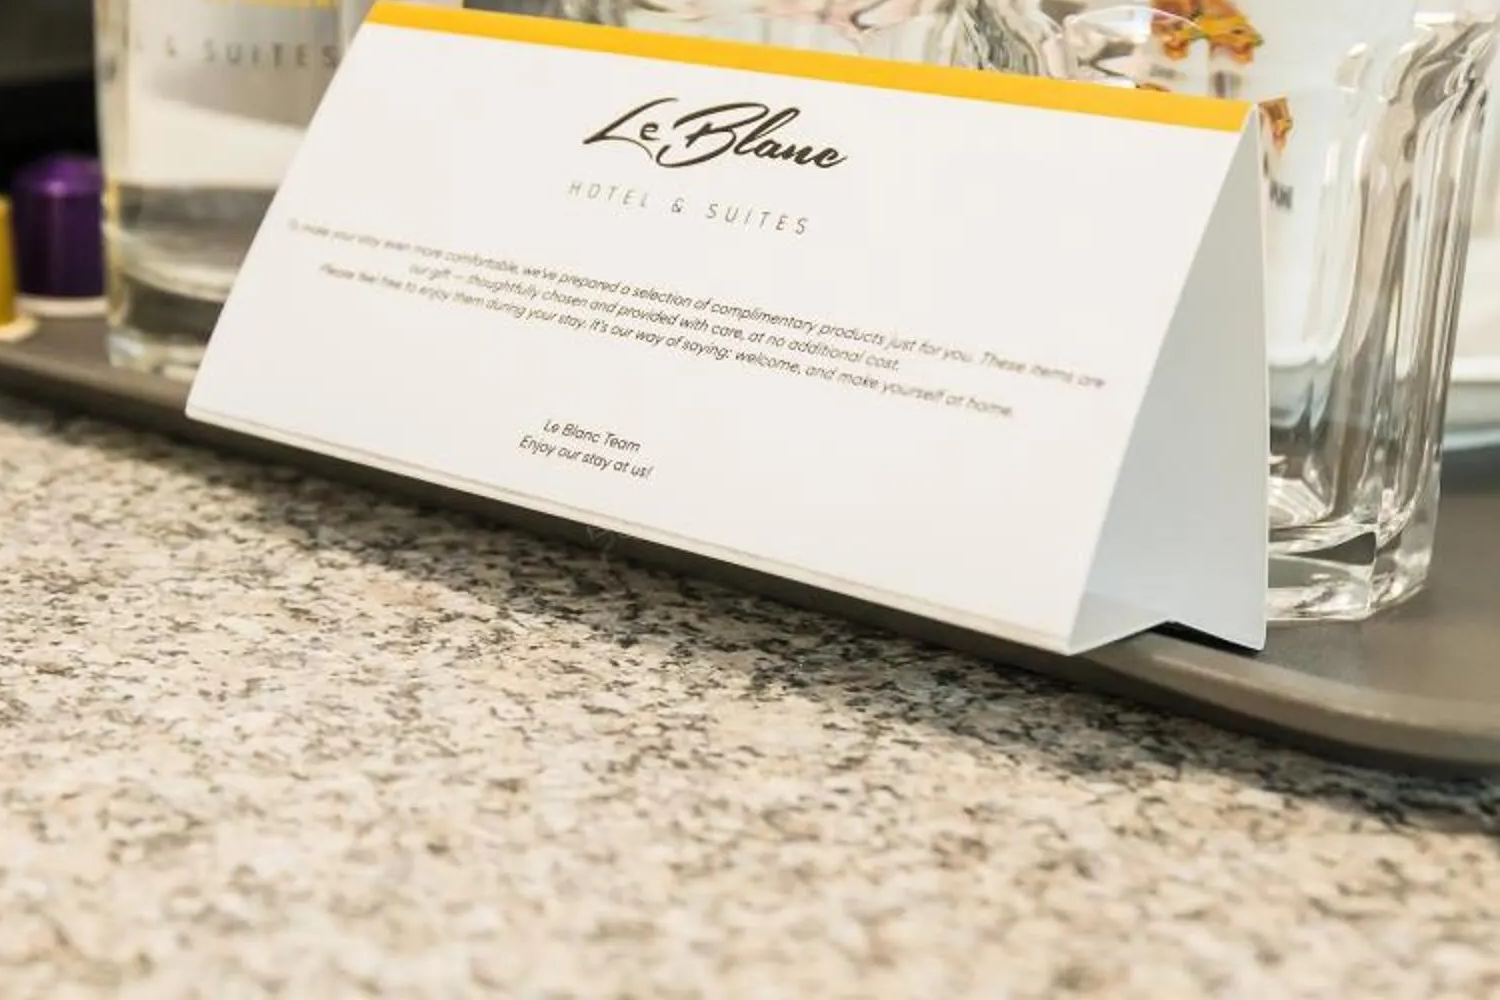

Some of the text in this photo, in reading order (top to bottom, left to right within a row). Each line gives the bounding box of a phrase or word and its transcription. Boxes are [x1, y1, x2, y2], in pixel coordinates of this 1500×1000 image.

[582, 97, 848, 168] Le Blanc
[568, 180, 809, 235] HOTEL & SUITES
[404, 280, 418, 293] to
[418, 285, 450, 302] enjoy
[451, 290, 485, 306] them
[485, 297, 527, 318] during
[525, 304, 558, 322] your
[610, 324, 634, 338] our
[634, 328, 666, 347] way
[665, 334, 686, 348] of
[681, 338, 732, 361] saying:
[734, 350, 802, 376] welcome,
[804, 363, 837, 381] and
[837, 371, 880, 390] make
[883, 381, 944, 401] yourself
[944, 393, 965, 407] at
[414, 244, 443, 259] more
[522, 266, 558, 281] we've
[558, 272, 623, 293] prepared
[621, 284, 631, 296] a
[632, 285, 693, 308] selection
[693, 297, 712, 311] of
[711, 301, 817, 334] complimentary
[818, 323, 886, 347] products
[884, 335, 917, 352] just
[918, 339, 943, 355] for
[980, 350, 1027, 374] These
[1029, 363, 1074, 384] items
[1077, 373, 1107, 389] are
[466, 273, 539, 300] thoughtfully
[541, 288, 589, 308] chosen
[589, 297, 620, 313] and
[616, 304, 681, 326] provided
[679, 314, 709, 332] with
[711, 321, 745, 341] care,
[746, 331, 765, 344] at
[765, 335, 786, 348] no
[787, 338, 865, 363] additional
[865, 354, 901, 373] cost.
[519, 434, 653, 477] Enjoy our stay at us!
[542, 419, 642, 453] Le Blanc Team
